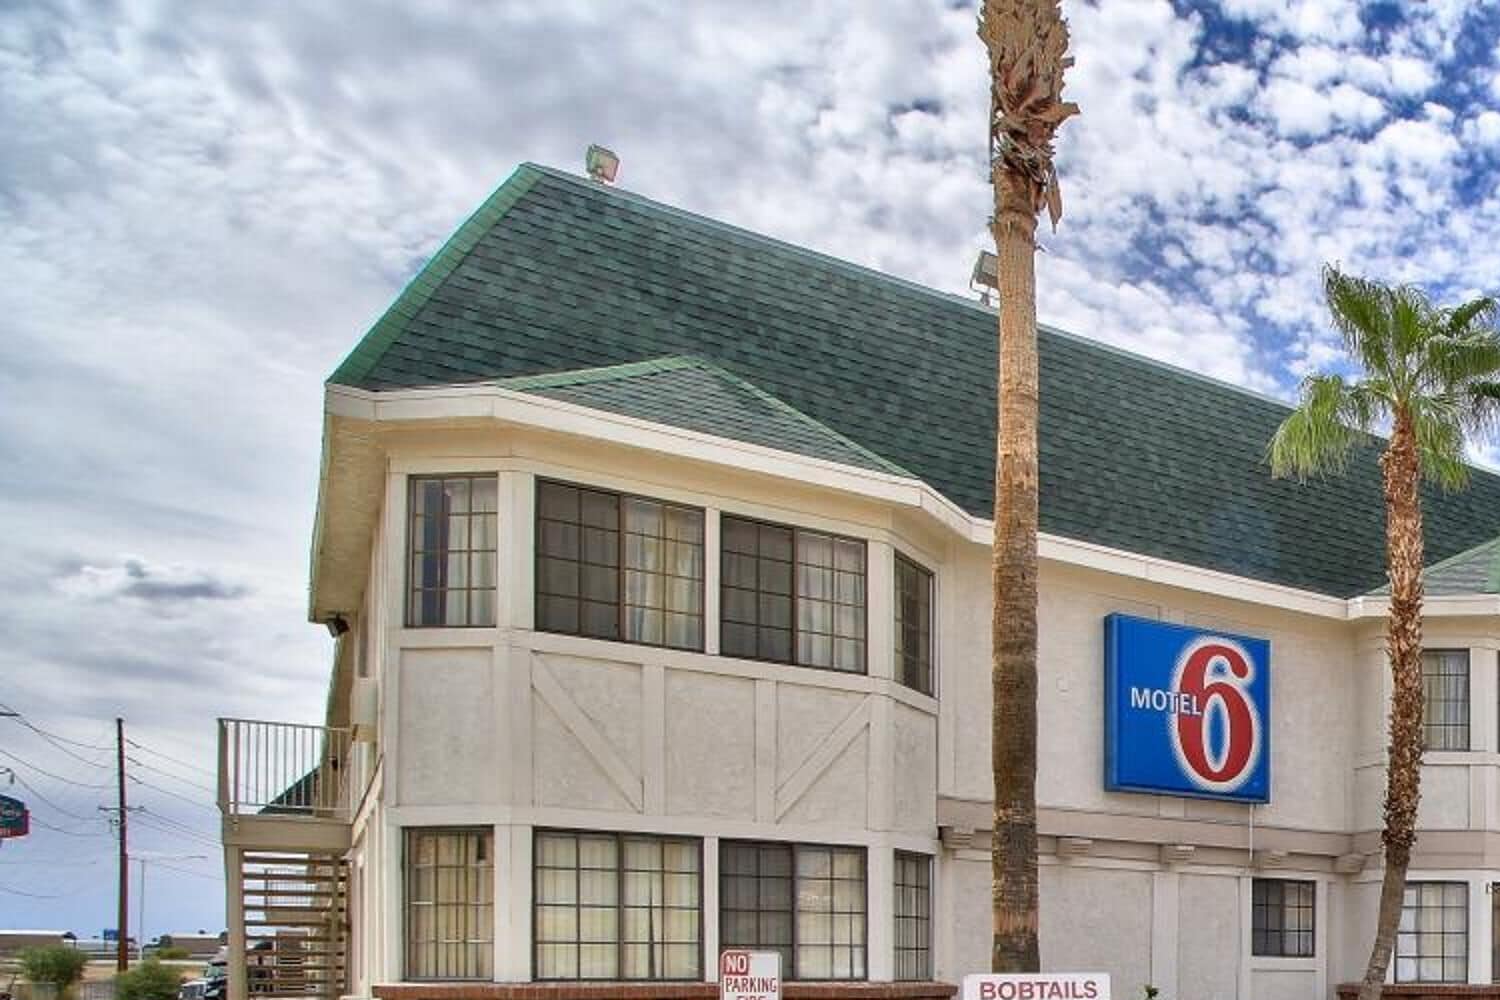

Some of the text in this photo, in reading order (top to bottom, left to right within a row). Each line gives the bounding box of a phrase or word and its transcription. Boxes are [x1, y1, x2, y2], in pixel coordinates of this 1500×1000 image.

[1131, 643, 1257, 785] MOTEL 6
[725, 955, 748, 973] NO
[725, 977, 778, 993] PARKING
[979, 980, 1098, 1000] BOBTAILS
